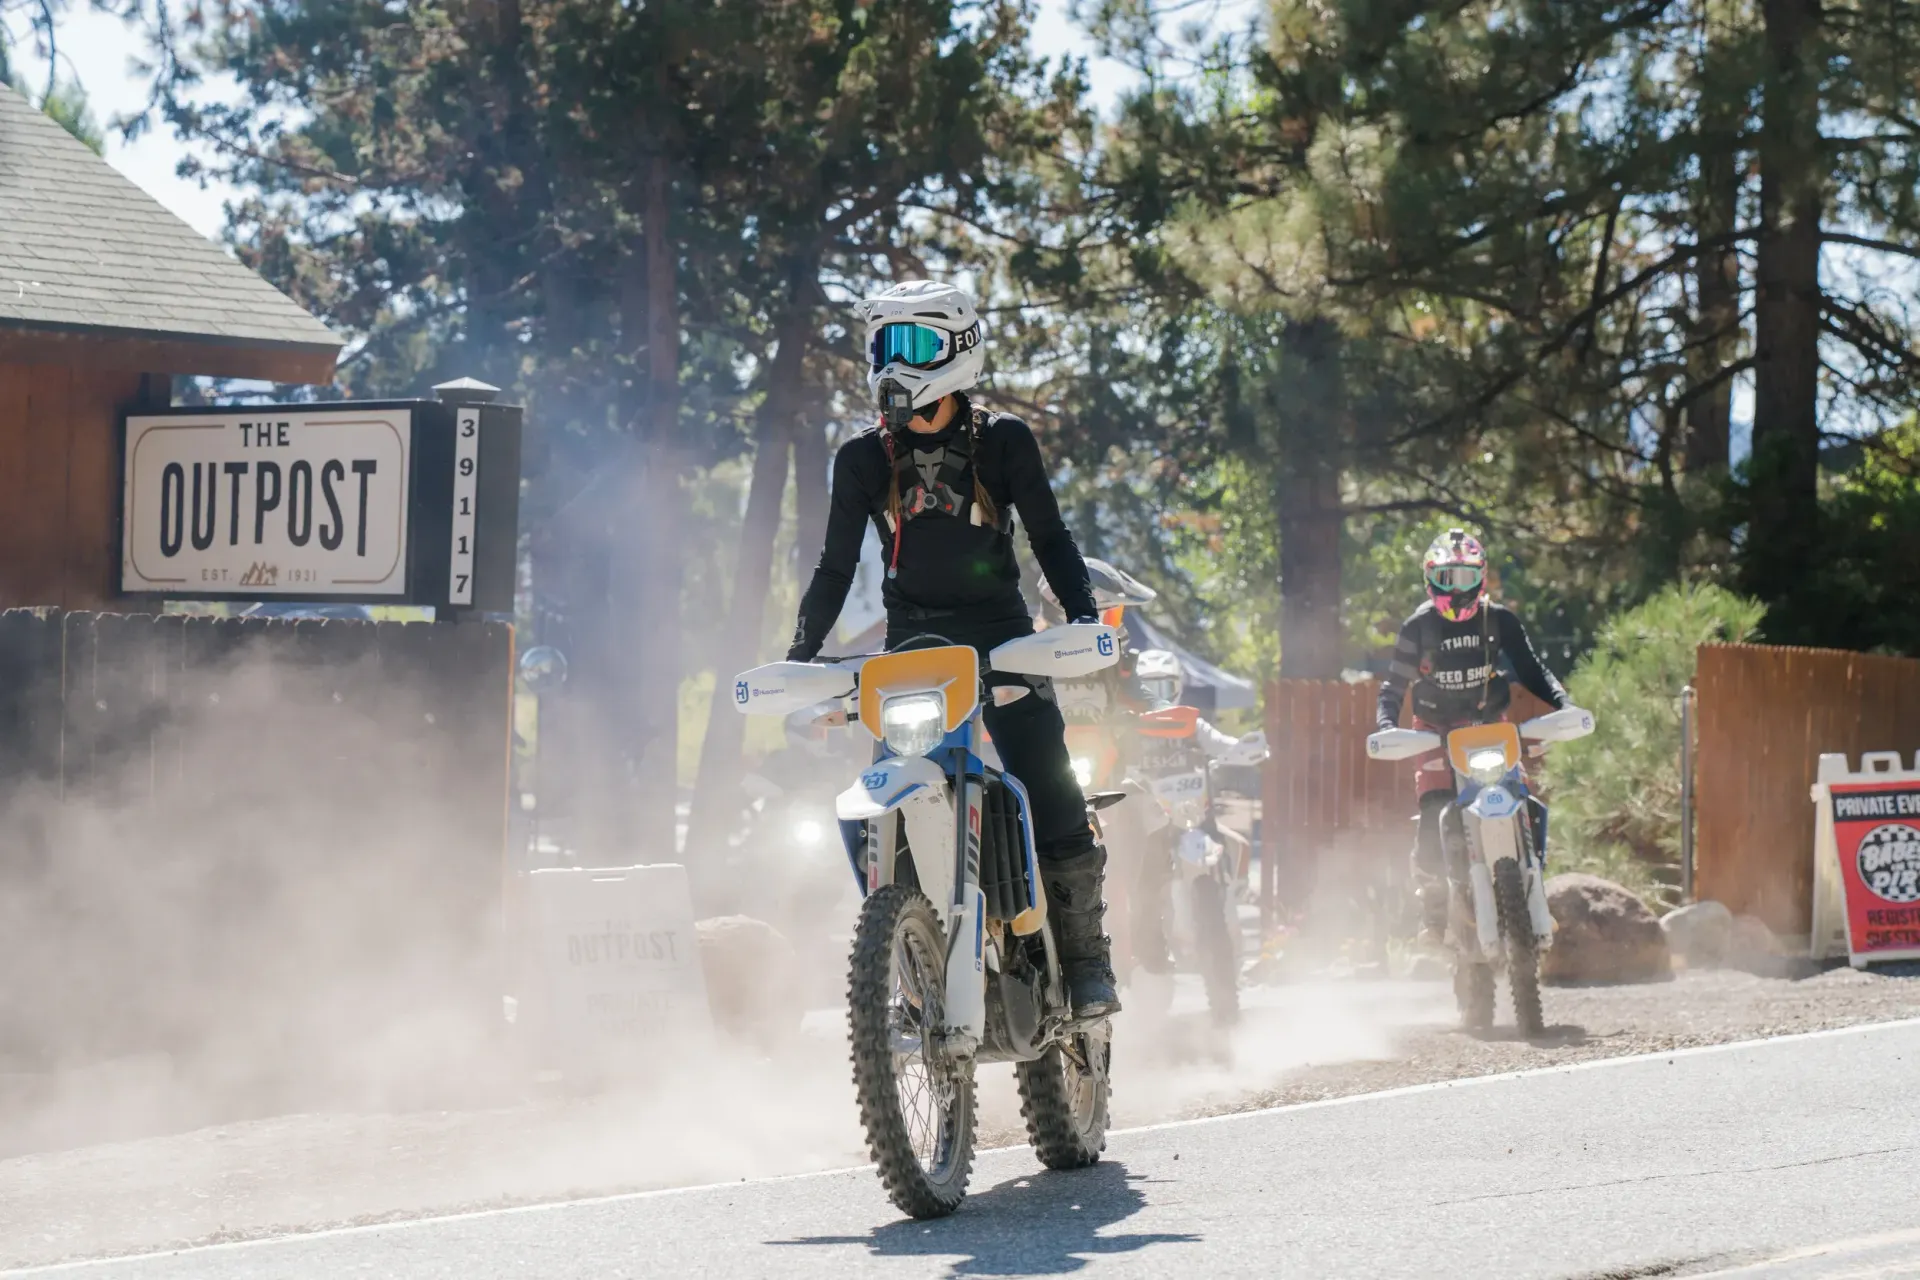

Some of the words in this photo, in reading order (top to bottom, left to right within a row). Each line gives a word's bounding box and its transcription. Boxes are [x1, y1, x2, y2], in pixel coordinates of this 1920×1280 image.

[955, 327, 982, 351] FOX
[239, 422, 290, 447] THE
[160, 459, 377, 558] OUTPOST
[454, 418, 476, 594] 39117
[201, 568, 233, 582] EST.
[287, 568, 318, 582] 1931
[1061, 646, 1093, 657] Husqvarna
[1434, 669, 1463, 684] EED
[1836, 796, 1896, 817] PRIVATE
[1862, 841, 1920, 871] BABE
[1872, 870, 1920, 889] DIR
[567, 931, 678, 966] OUTPOST
